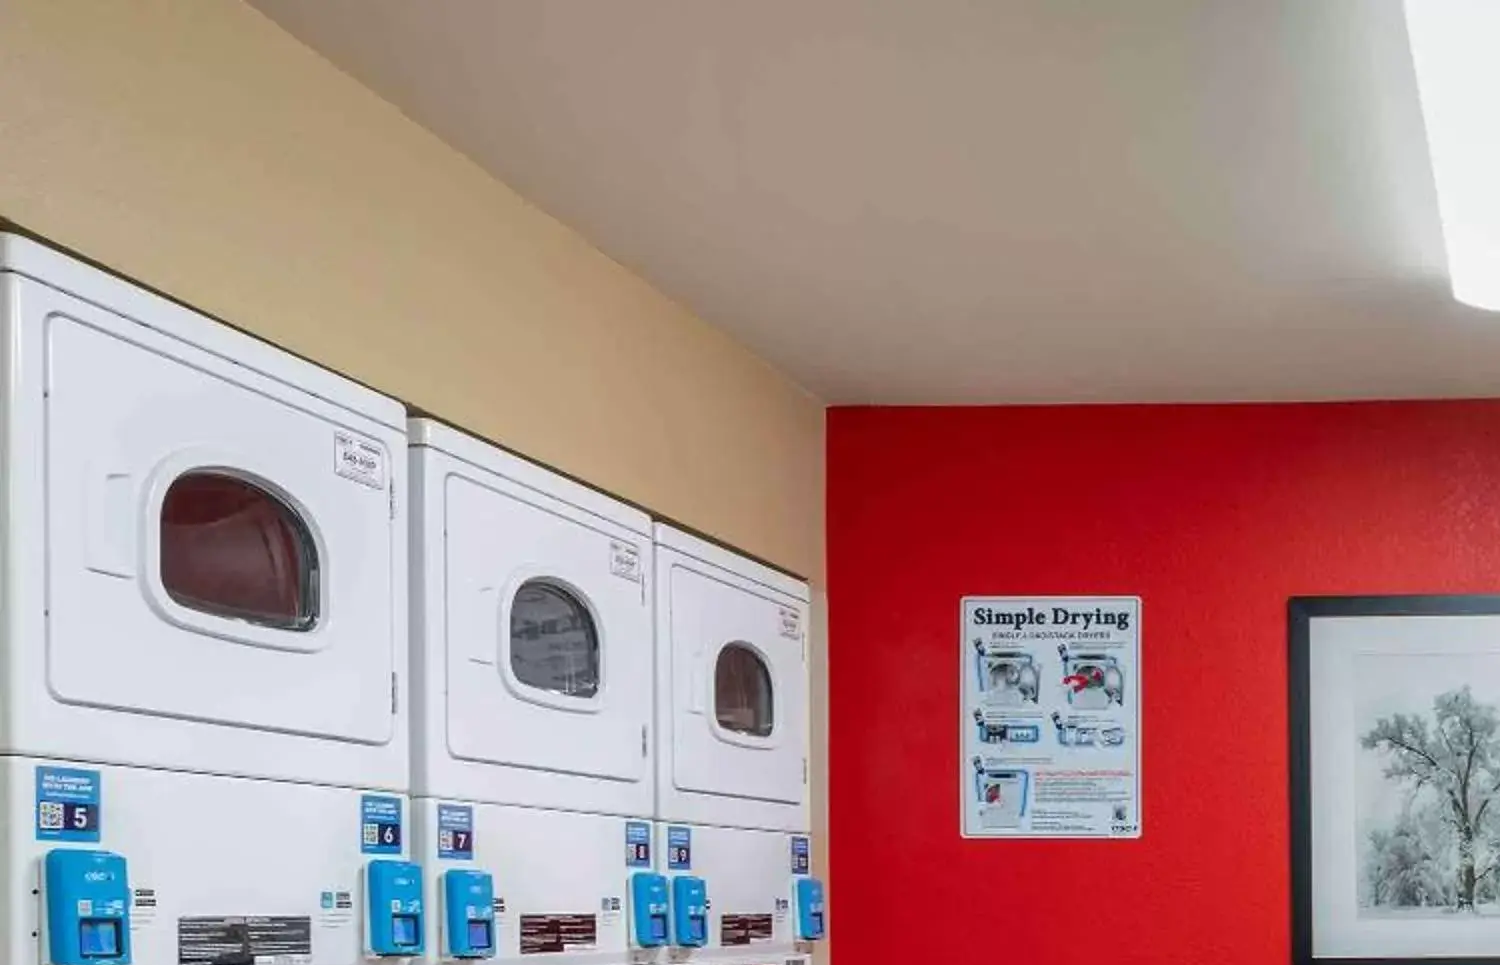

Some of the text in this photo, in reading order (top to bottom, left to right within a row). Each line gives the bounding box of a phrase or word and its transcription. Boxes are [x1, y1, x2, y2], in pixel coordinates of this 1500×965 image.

[973, 607, 1129, 630] Simple Drying
[74, 807, 87, 829] 5
[383, 826, 394, 843] 6
[457, 833, 467, 849] 7
[680, 849, 687, 862] 9
